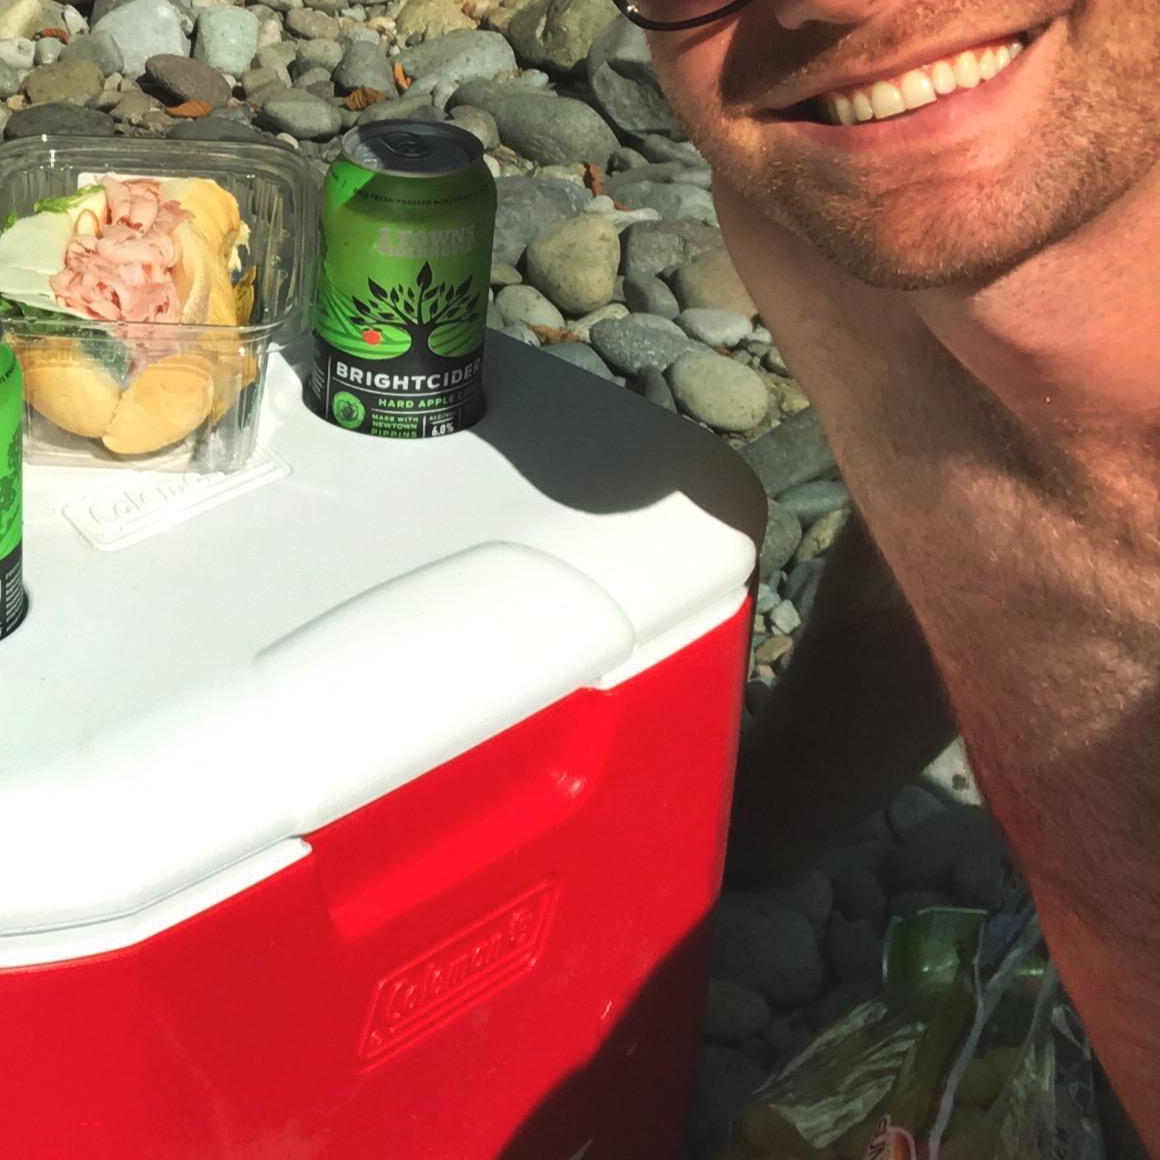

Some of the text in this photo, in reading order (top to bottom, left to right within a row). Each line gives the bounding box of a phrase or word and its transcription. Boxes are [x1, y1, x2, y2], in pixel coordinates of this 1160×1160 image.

[378, 398, 414, 408] HARD
[418, 394, 455, 408] APPLE
[372, 421, 417, 429] NEWTOWN
